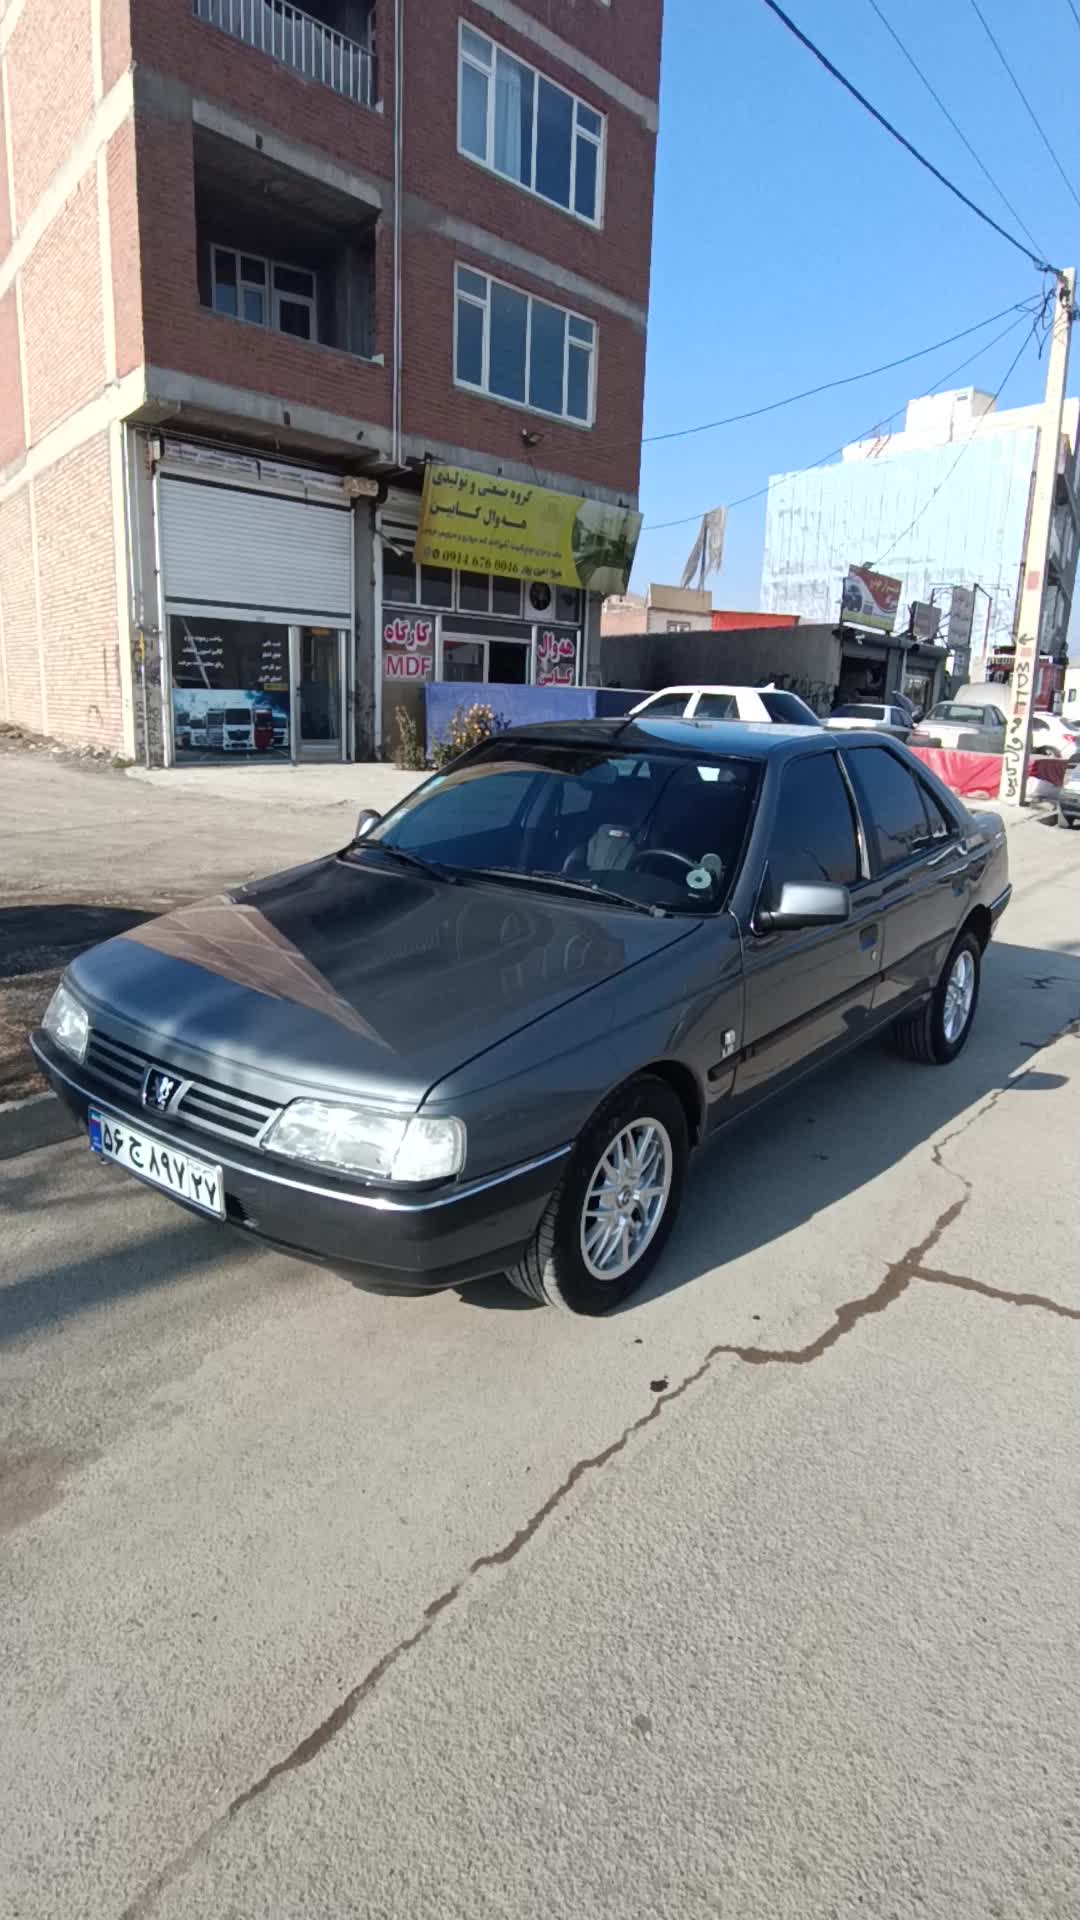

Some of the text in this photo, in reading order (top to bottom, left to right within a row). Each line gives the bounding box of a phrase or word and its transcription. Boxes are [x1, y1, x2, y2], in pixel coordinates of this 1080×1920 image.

[432, 471, 468, 491] تولیدی
[469, 480, 476, 495] و
[510, 489, 533, 506] گروه
[442, 549, 469, 565] 0914
[386, 654, 431, 676] MDF
[103, 1123, 123, 1155] ۵۶
[129, 1135, 144, 1168] ج
[149, 1146, 185, 1189] ۸۹۷
[191, 1172, 216, 1206] ۲۷
